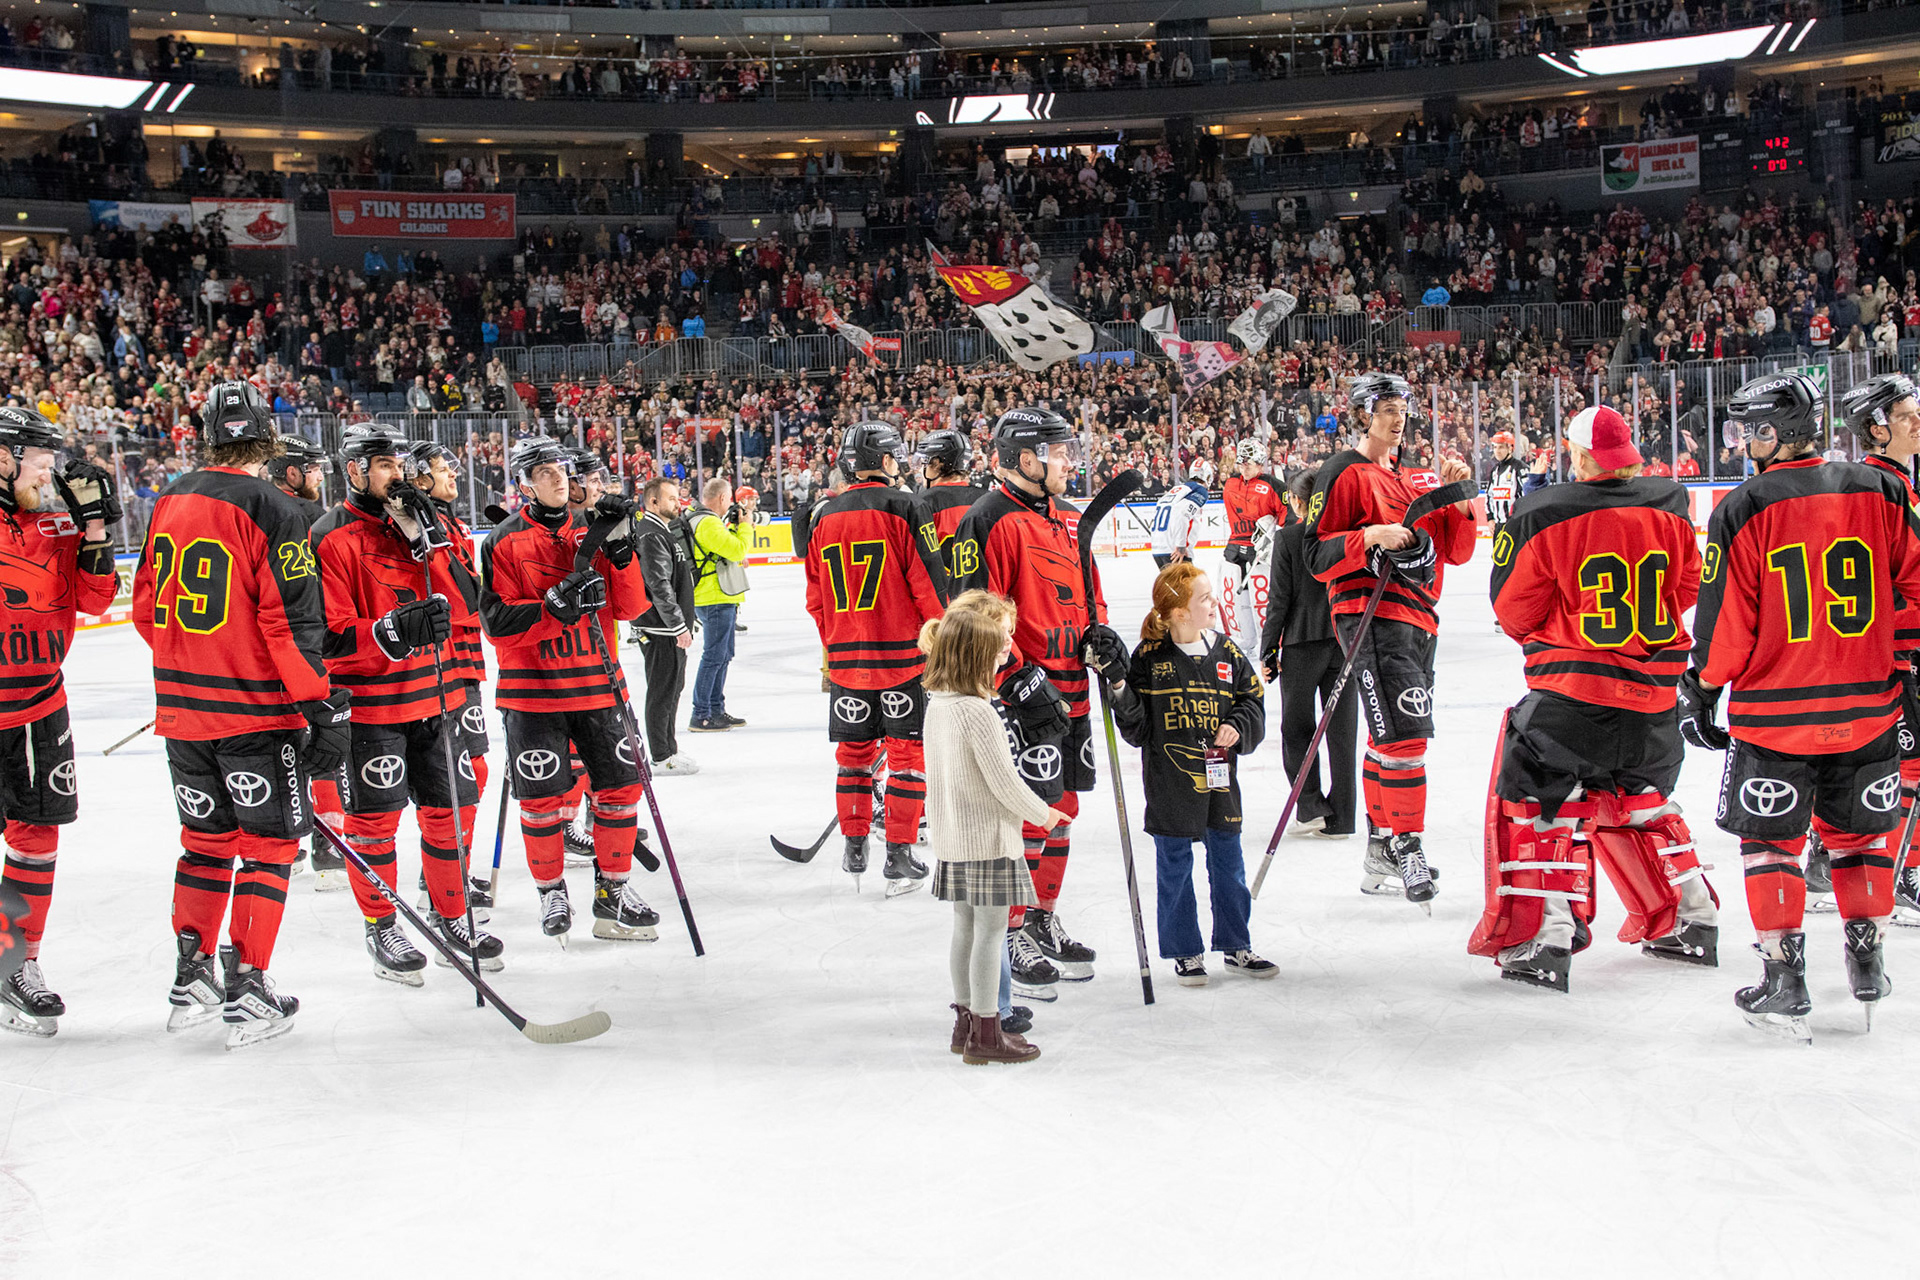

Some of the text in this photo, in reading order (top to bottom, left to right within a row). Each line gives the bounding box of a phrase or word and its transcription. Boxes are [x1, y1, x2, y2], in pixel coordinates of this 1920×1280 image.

[1782, 136, 1790, 149] 2
[360, 200, 486, 220] FUN SHARKS
[400, 223, 448, 233] COLOGNE
[226, 395, 239, 405] 29
[1745, 377, 1792, 400] STETSON
[1003, 411, 1043, 425] STETSON
[919, 521, 940, 553] 17
[278, 538, 318, 582] 29
[820, 539, 887, 613] 17
[952, 538, 979, 579] 13
[1701, 542, 1721, 584] 9
[153, 532, 234, 635] 29
[1578, 549, 1678, 648] 30
[1766, 536, 1876, 644] 19
[1044, 621, 1083, 659] KÖ
[1018, 666, 1047, 702] BAU
[1328, 661, 1352, 712] SYNC
[1164, 712, 1220, 736] Energ
[1367, 688, 1386, 738] TOYOTA
[286, 767, 303, 827] TOYOTA
[338, 761, 351, 805] YOTA
[364, 871, 408, 912] SYNC
[191, 984, 210, 1000] CCM
[243, 996, 279, 1019] CCM
